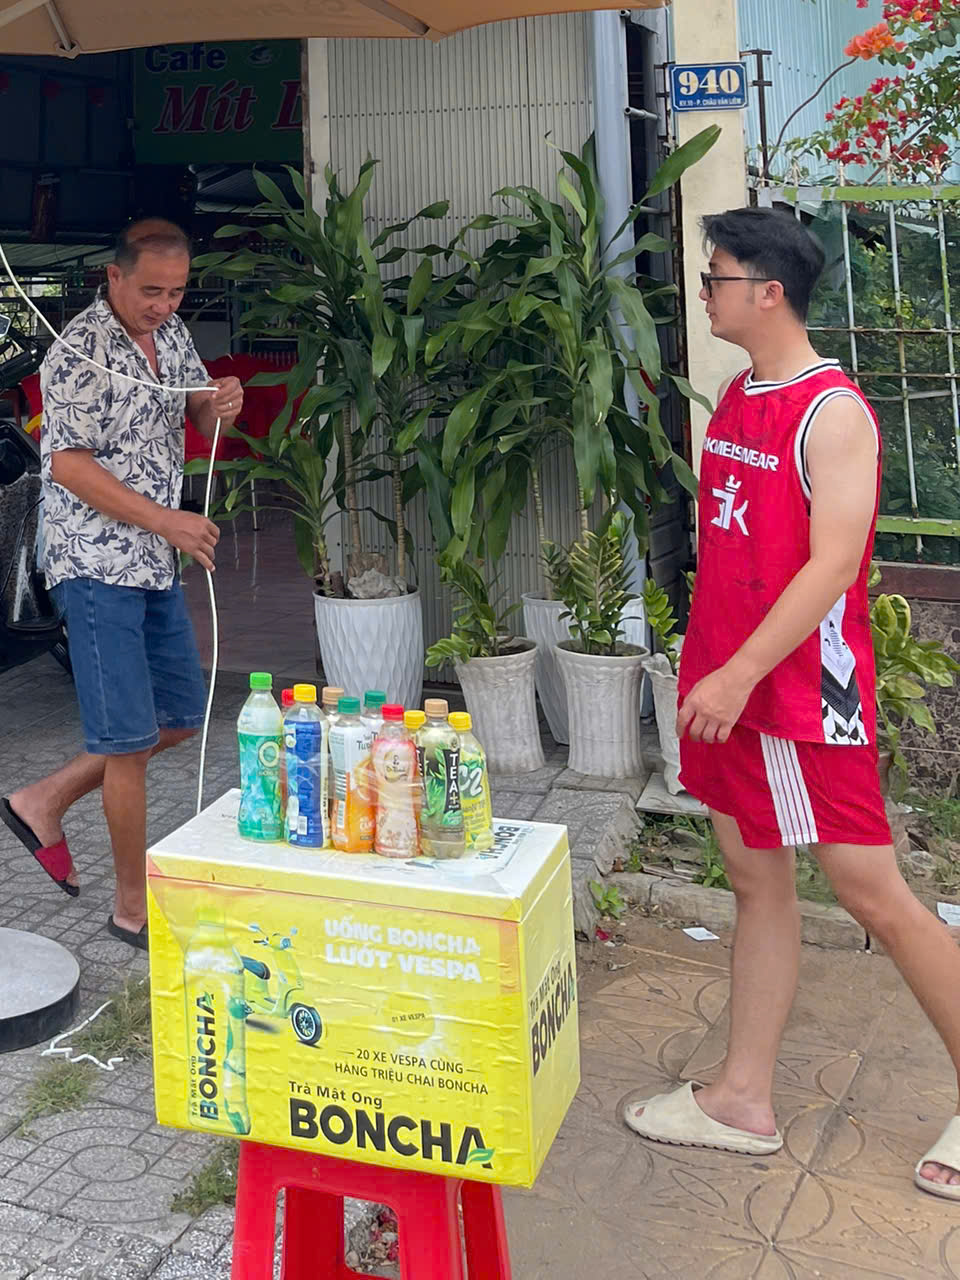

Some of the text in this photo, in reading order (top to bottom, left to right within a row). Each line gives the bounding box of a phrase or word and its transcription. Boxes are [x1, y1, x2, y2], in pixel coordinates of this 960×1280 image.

[678, 68, 740, 96] 940
[152, 79, 257, 134] Mít
[387, 927, 481, 956] BONCHA
[397, 952, 483, 984] VESPA
[408, 1012, 426, 1021] VESPA
[531, 961, 575, 1078] BONCHA
[196, 993, 219, 1121] BONCHA
[356, 1048, 464, 1074] 20 XE VESPA CÙNG
[289, 1080, 383, 1110] Trà Mật Ong
[371, 1067, 403, 1084] TRIỆU
[406, 1073, 434, 1087] CHAI
[438, 1078, 489, 1095] BONCHA
[289, 1097, 494, 1170] BONCHA
